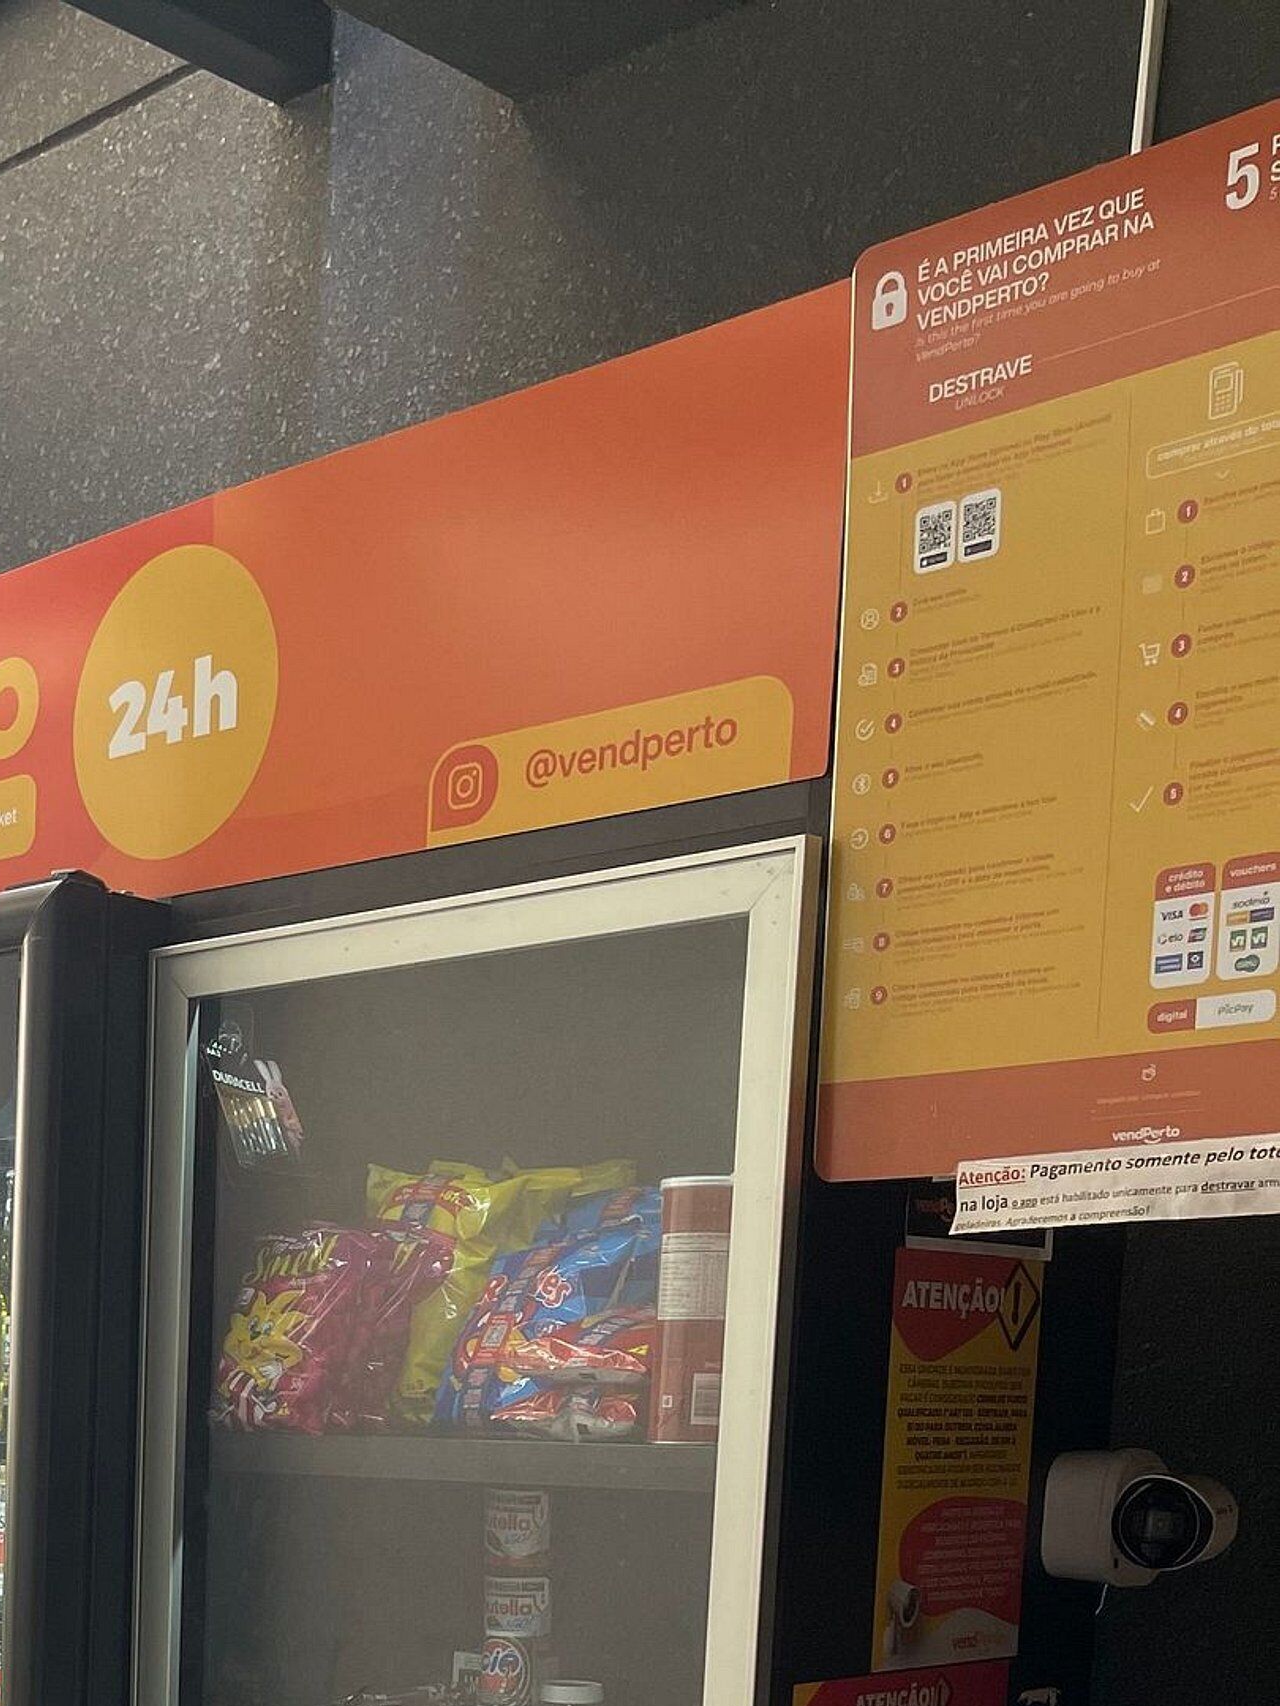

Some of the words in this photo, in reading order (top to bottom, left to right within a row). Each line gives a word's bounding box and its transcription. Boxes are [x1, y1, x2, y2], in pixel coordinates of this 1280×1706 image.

[1225, 142, 1260, 210] 5
[918, 259, 930, 282] É
[935, 258, 948, 277] A
[953, 223, 1048, 271] PRIMEIRA
[1054, 206, 1095, 235] VEZ
[1099, 188, 1144, 220] QUE
[918, 270, 973, 306] VOCÊ
[977, 261, 1008, 286] VAI
[1013, 224, 1119, 275] COMPRAR
[1123, 212, 1154, 238] NA
[917, 272, 1049, 331] VENDPERTO?
[1070, 278, 1105, 299] going
[1122, 264, 1144, 281] buy
[1147, 258, 1161, 272] at
[929, 354, 1033, 403] DESTRAVE
[107, 654, 238, 760] 24h
[525, 715, 738, 789] @vendperto
[1161, 910, 1184, 921] VISA
[212, 1069, 265, 1096] DURACELL
[958, 1166, 1026, 1188] Atenção:
[1030, 1157, 1121, 1181] Pagamento
[1125, 1151, 1200, 1169] somente
[1205, 1146, 1244, 1167] pelo
[960, 1199, 977, 1213] na
[981, 1194, 1009, 1213] loja
[1200, 1177, 1256, 1194] destravar
